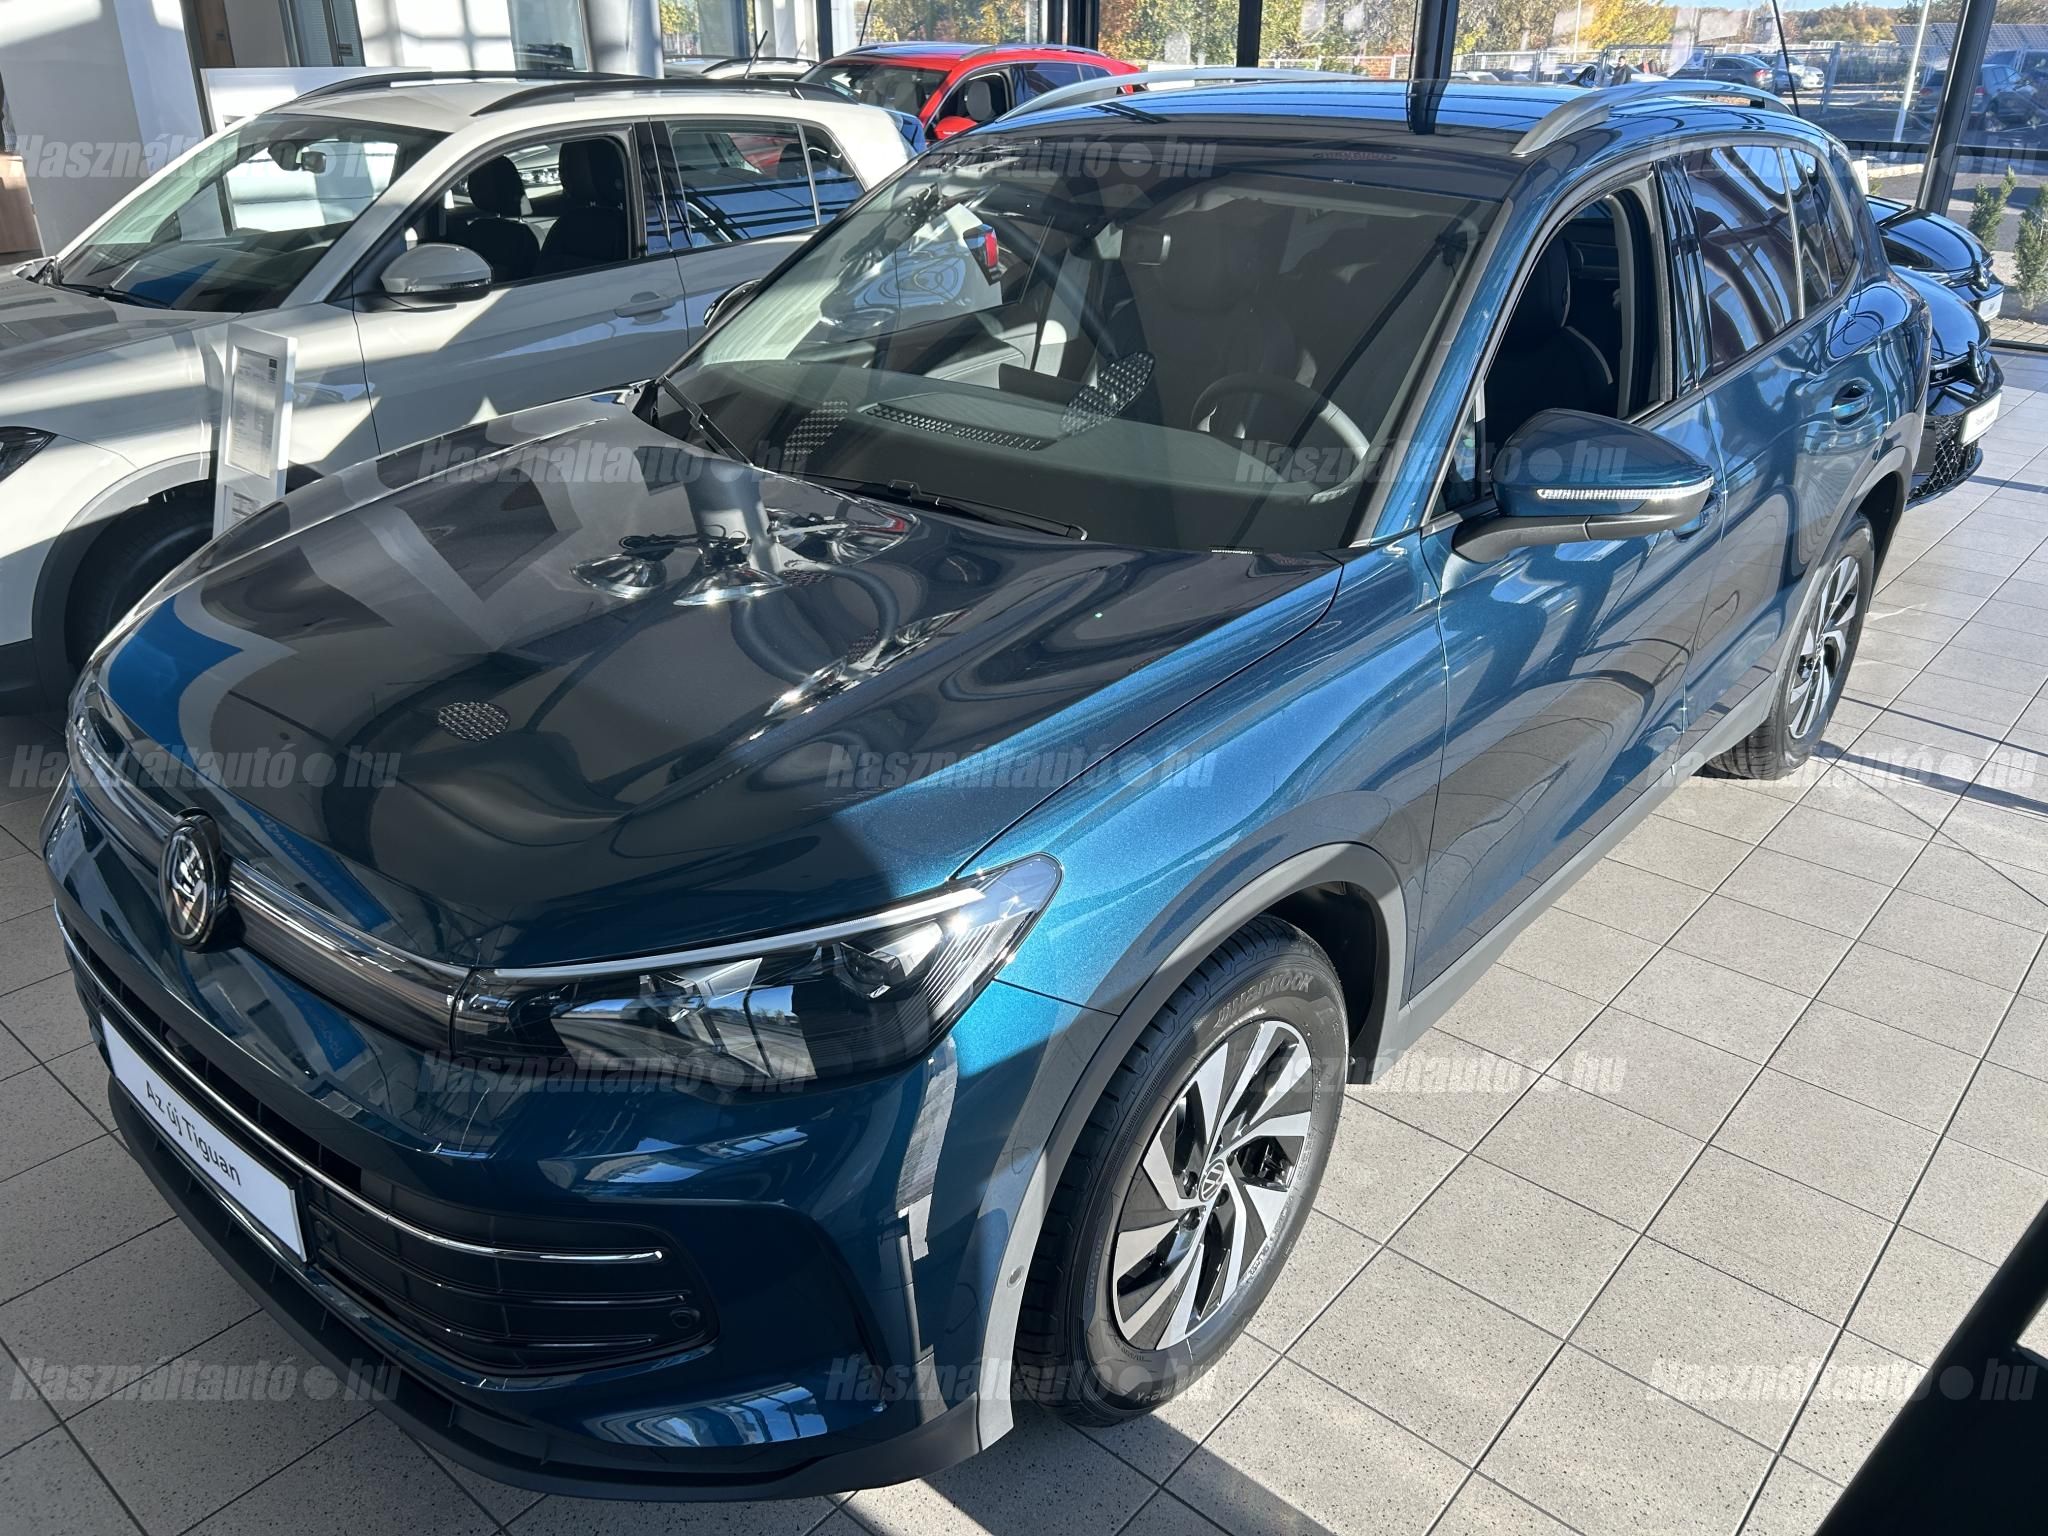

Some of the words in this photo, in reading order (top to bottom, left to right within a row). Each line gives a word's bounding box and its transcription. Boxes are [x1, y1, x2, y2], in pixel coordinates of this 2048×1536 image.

[145, 1080, 165, 1113] Az
[167, 1102, 181, 1137] új
[181, 1116, 241, 1186] Tiguan
